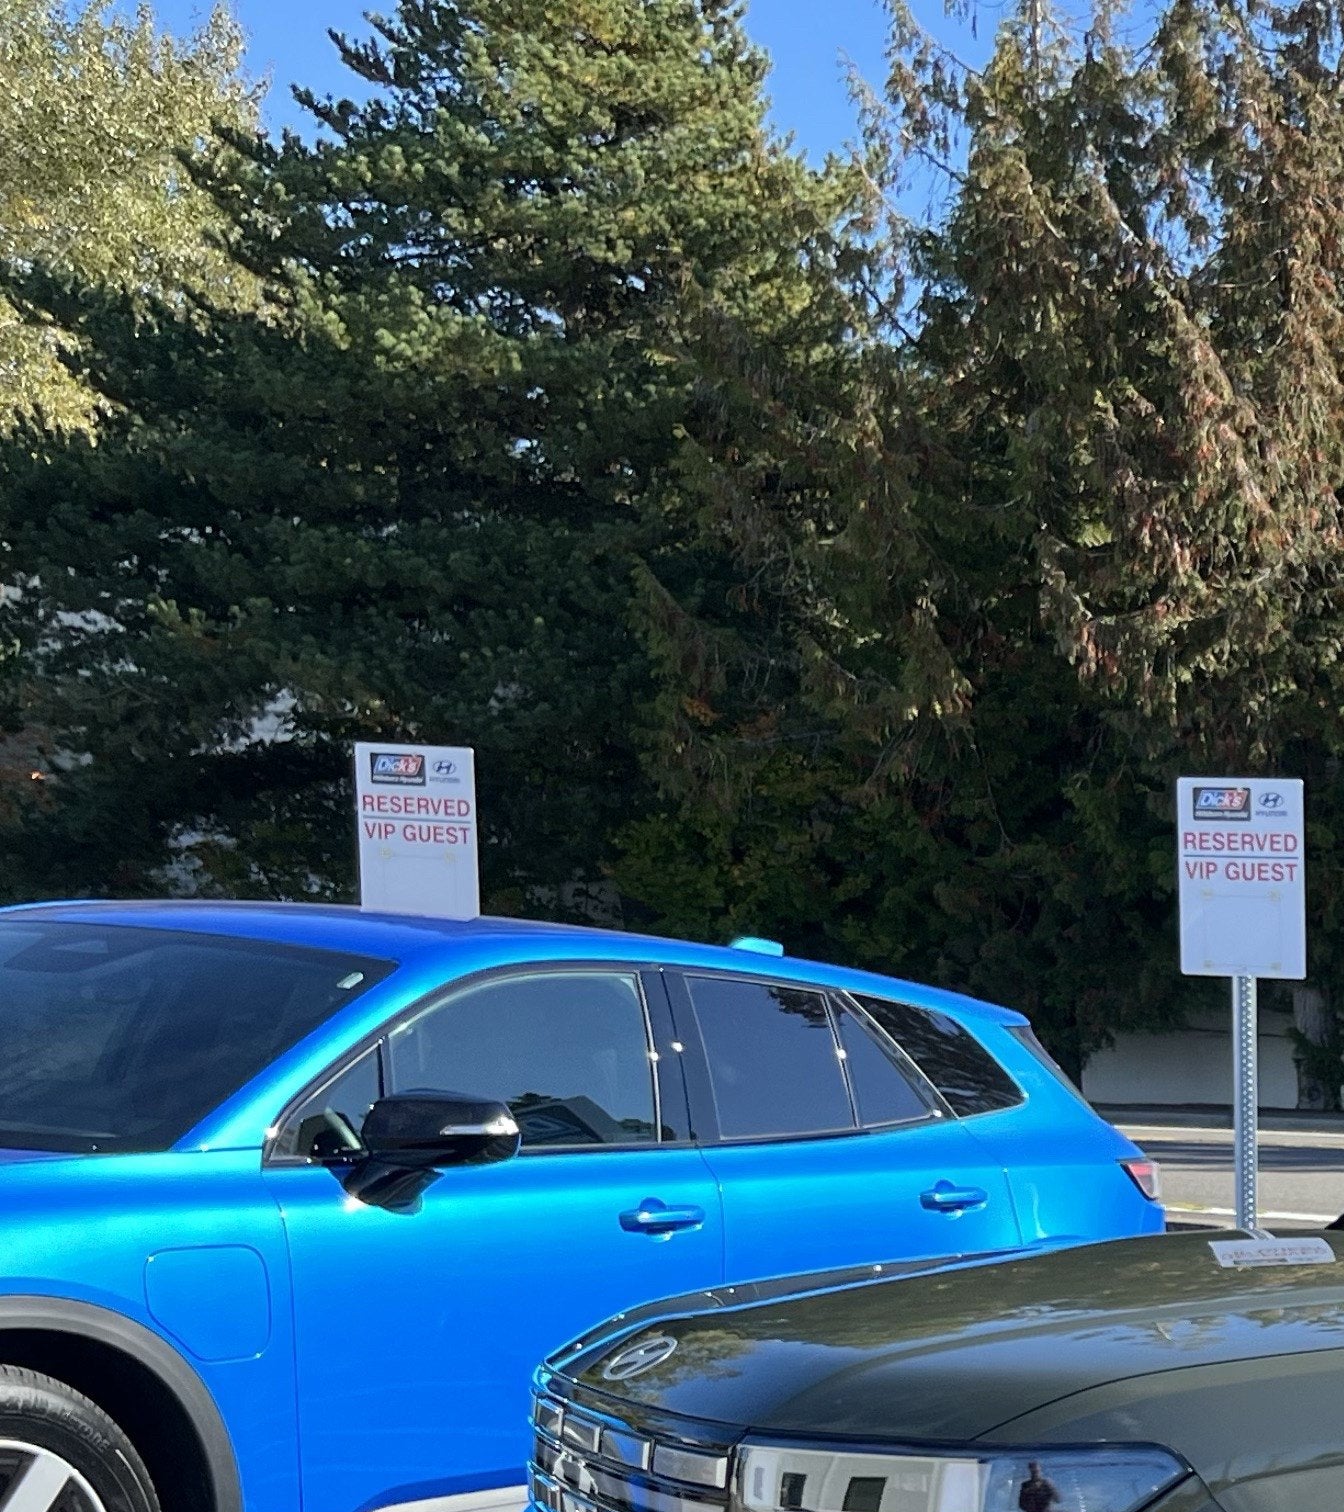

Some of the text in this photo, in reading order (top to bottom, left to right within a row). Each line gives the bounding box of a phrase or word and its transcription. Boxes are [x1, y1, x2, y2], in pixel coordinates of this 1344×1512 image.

[362, 794, 471, 817] RESERVED
[364, 822, 471, 844] VIP GUEST
[1183, 831, 1298, 852] RESERVED
[1185, 861, 1298, 882] VIP GUEST
